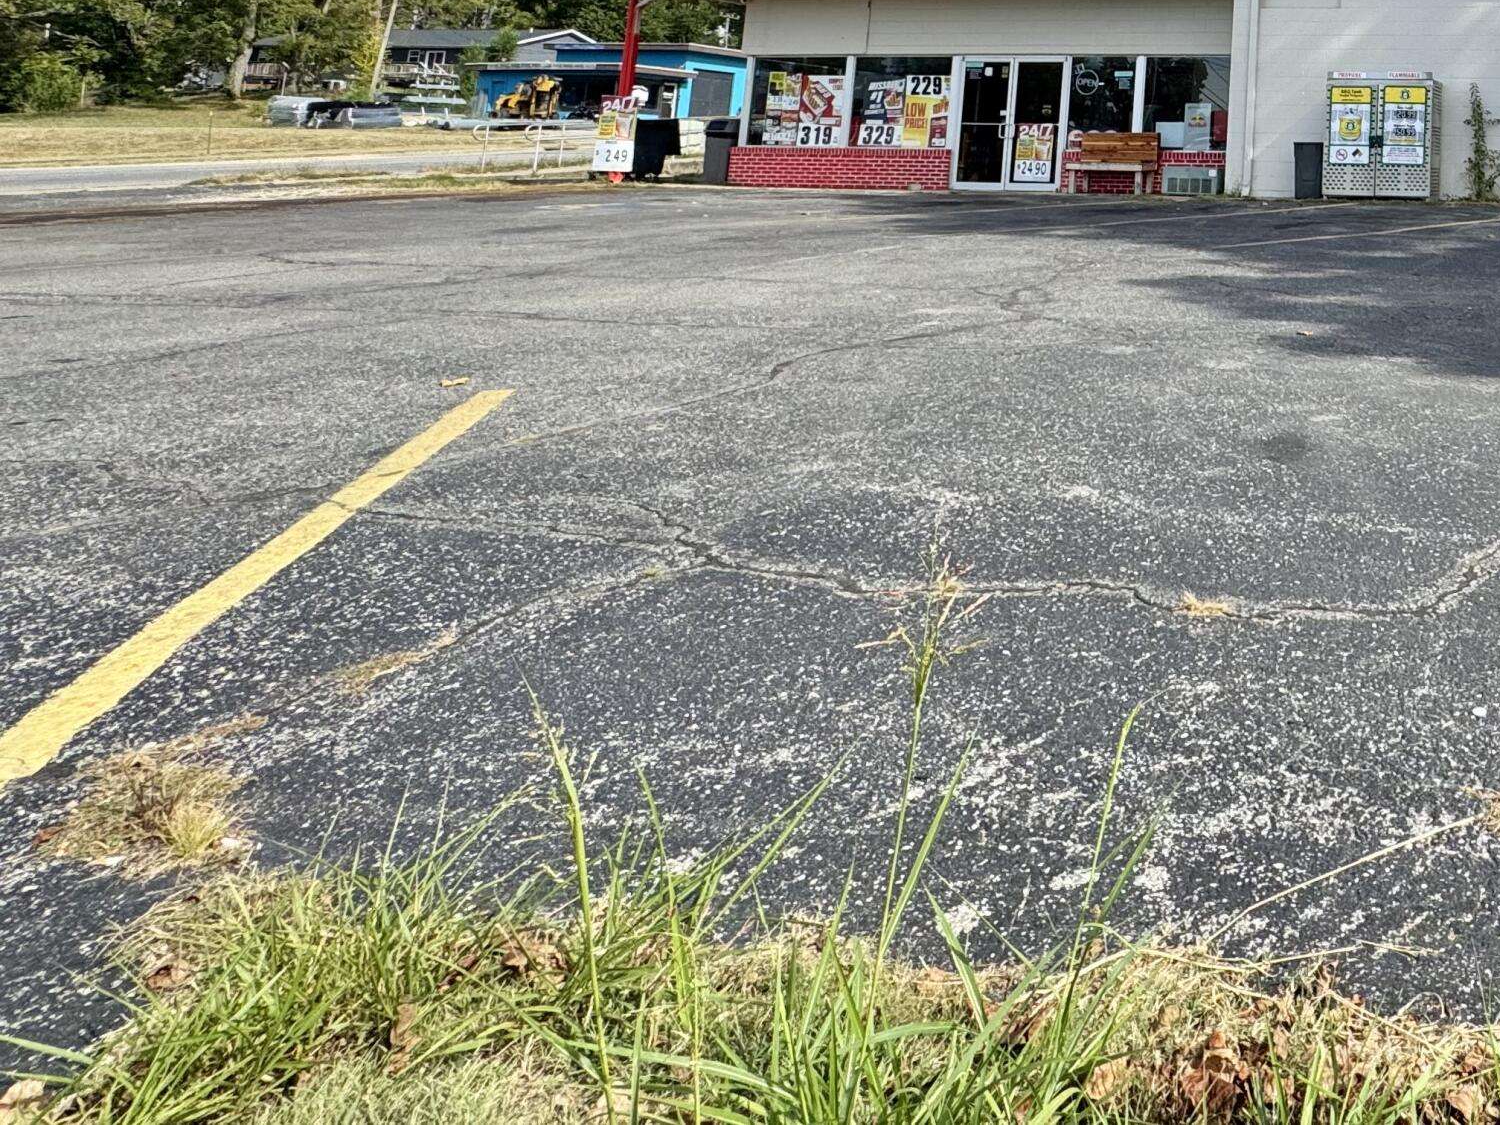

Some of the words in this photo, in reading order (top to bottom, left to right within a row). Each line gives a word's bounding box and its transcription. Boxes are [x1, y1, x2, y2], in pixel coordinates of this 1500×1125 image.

[910, 76, 942, 95] 229
[1077, 77, 1099, 88] OPEN
[905, 102, 927, 117] LOW
[800, 125, 832, 145] 319
[862, 125, 895, 145] 329
